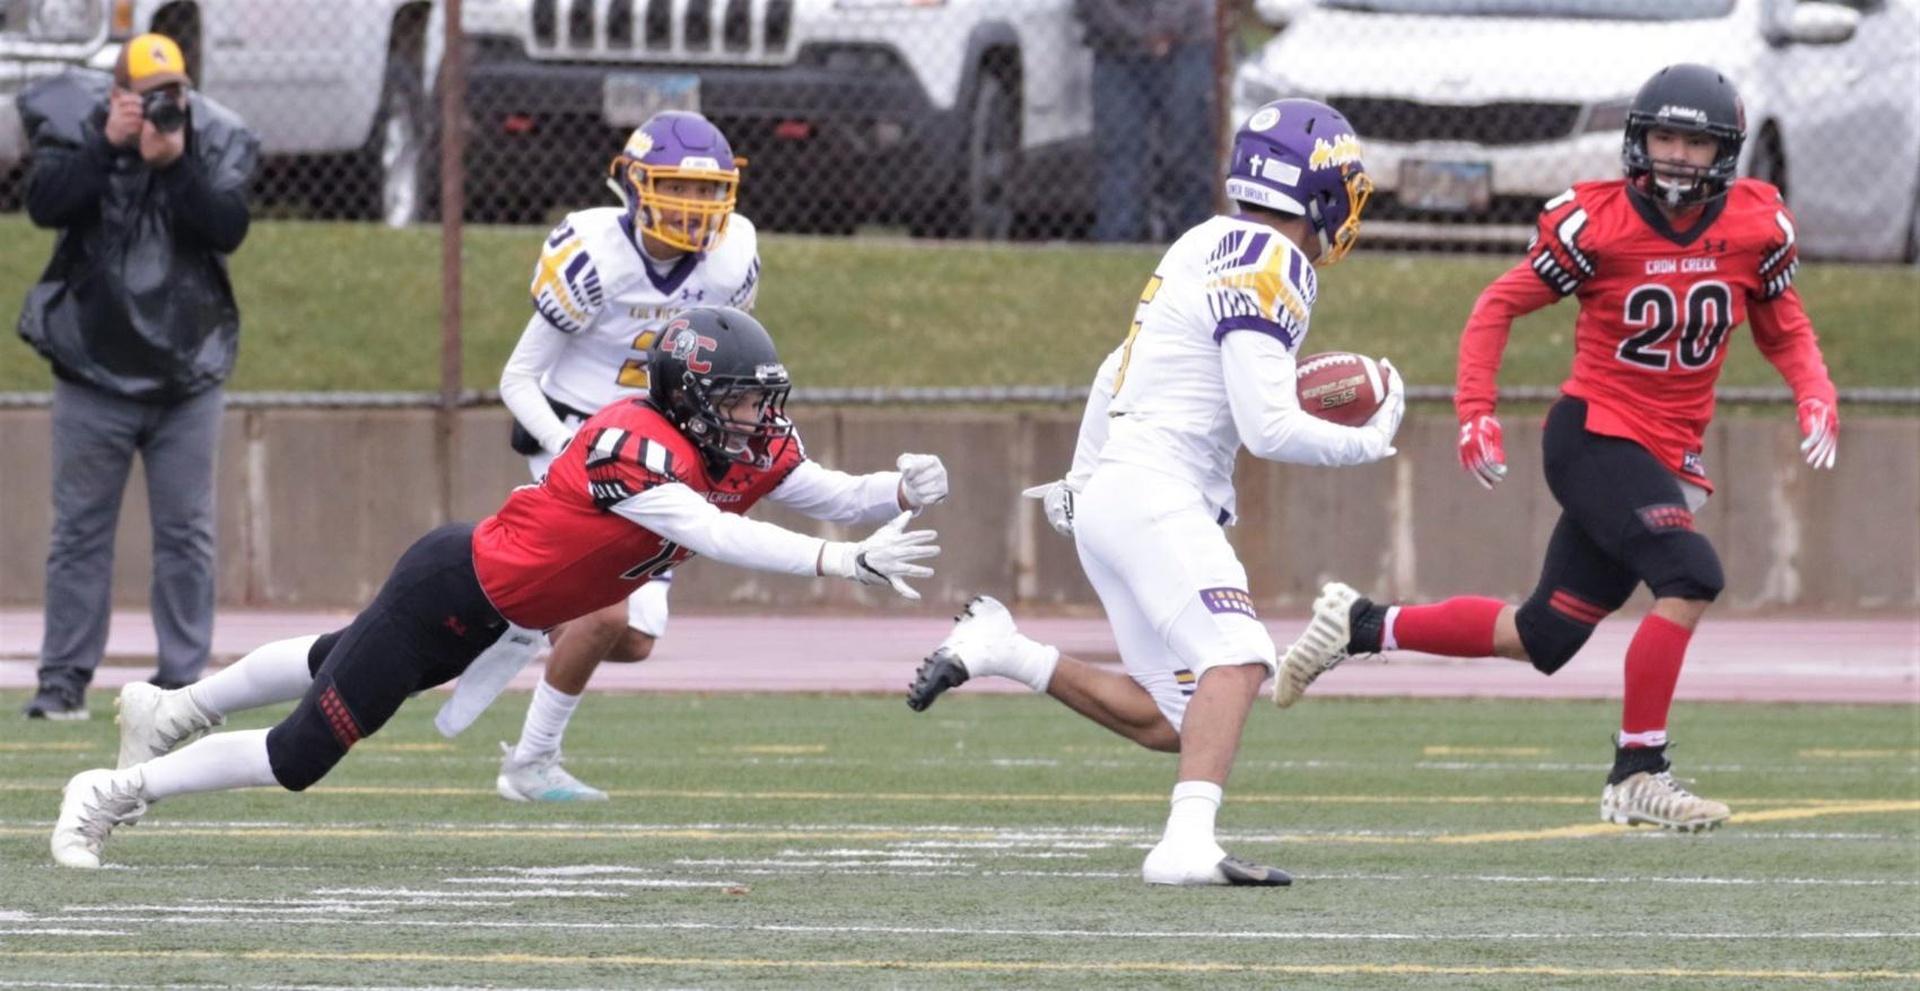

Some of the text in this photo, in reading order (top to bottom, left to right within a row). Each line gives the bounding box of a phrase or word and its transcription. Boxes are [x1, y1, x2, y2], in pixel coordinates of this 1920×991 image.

[1645, 257, 1718, 275] CROW CREEK
[1616, 280, 1733, 371] 20
